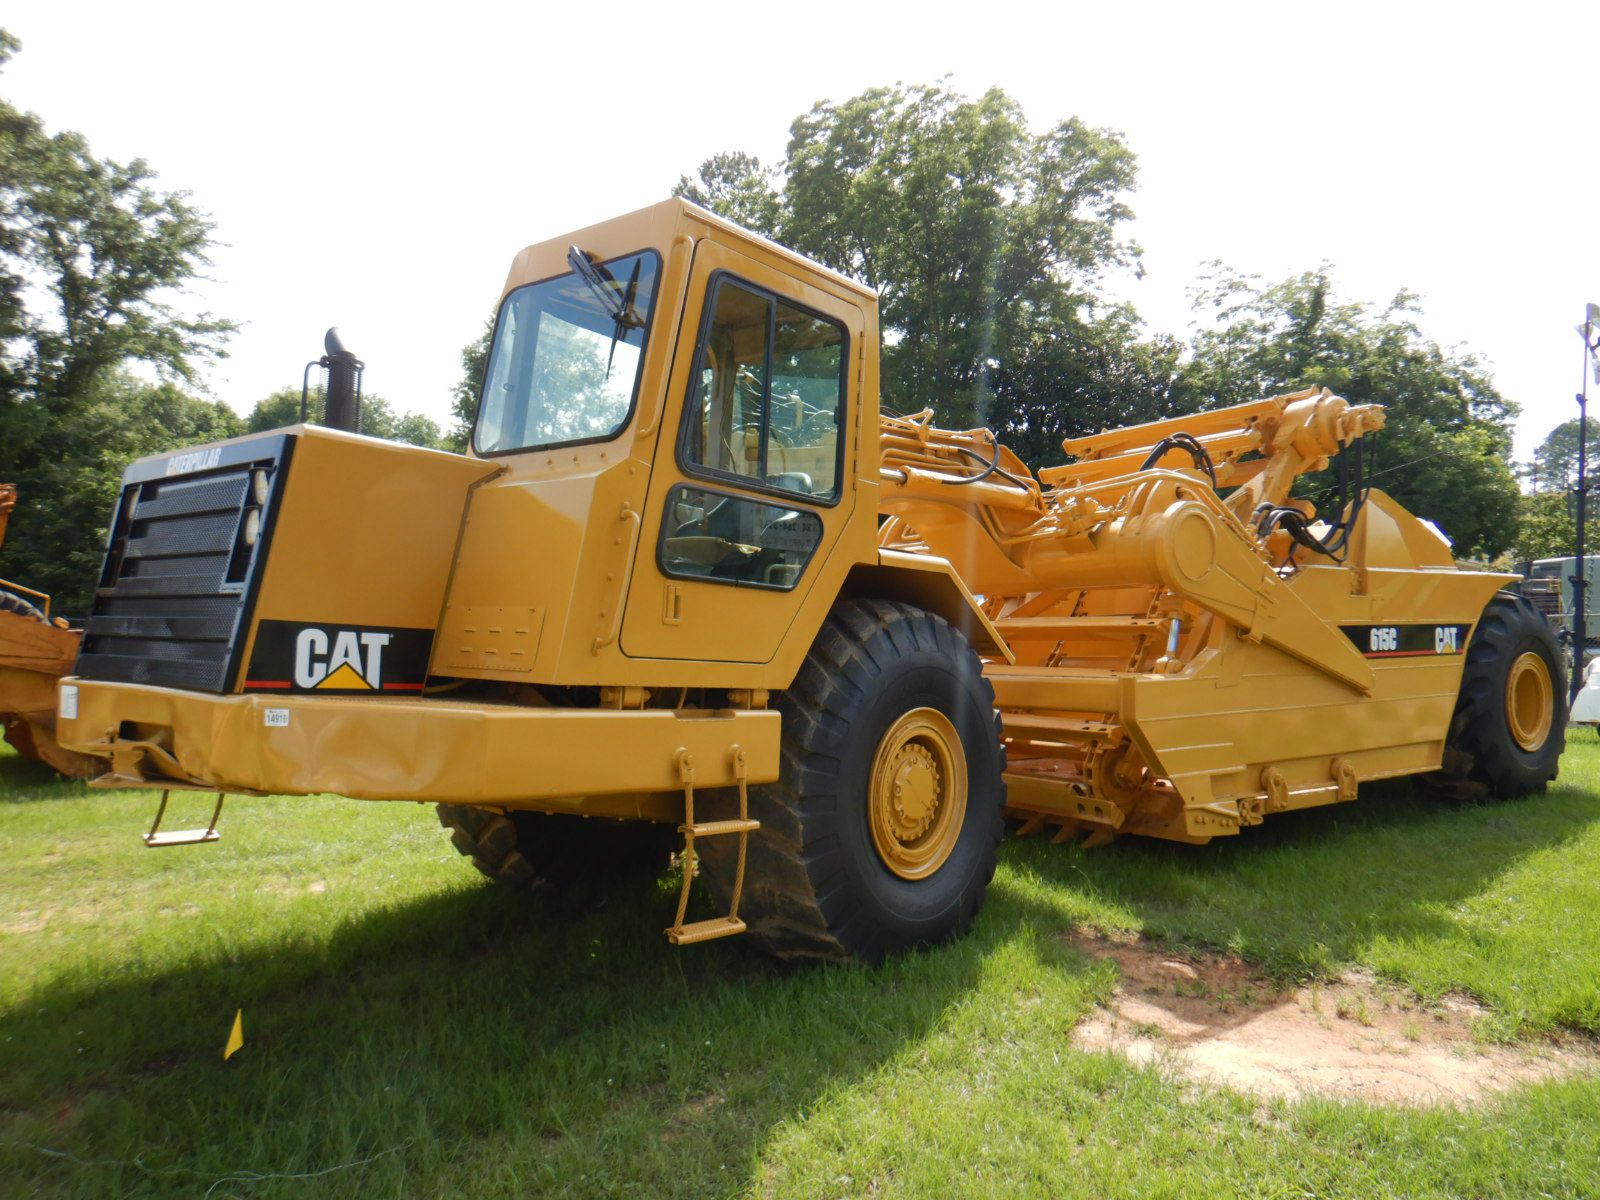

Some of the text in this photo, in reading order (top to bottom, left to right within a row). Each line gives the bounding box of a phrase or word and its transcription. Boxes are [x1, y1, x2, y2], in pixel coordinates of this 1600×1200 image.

[1370, 627, 1397, 651] 615C
[1435, 627, 1457, 653] CAT
[295, 628, 390, 690] CAT
